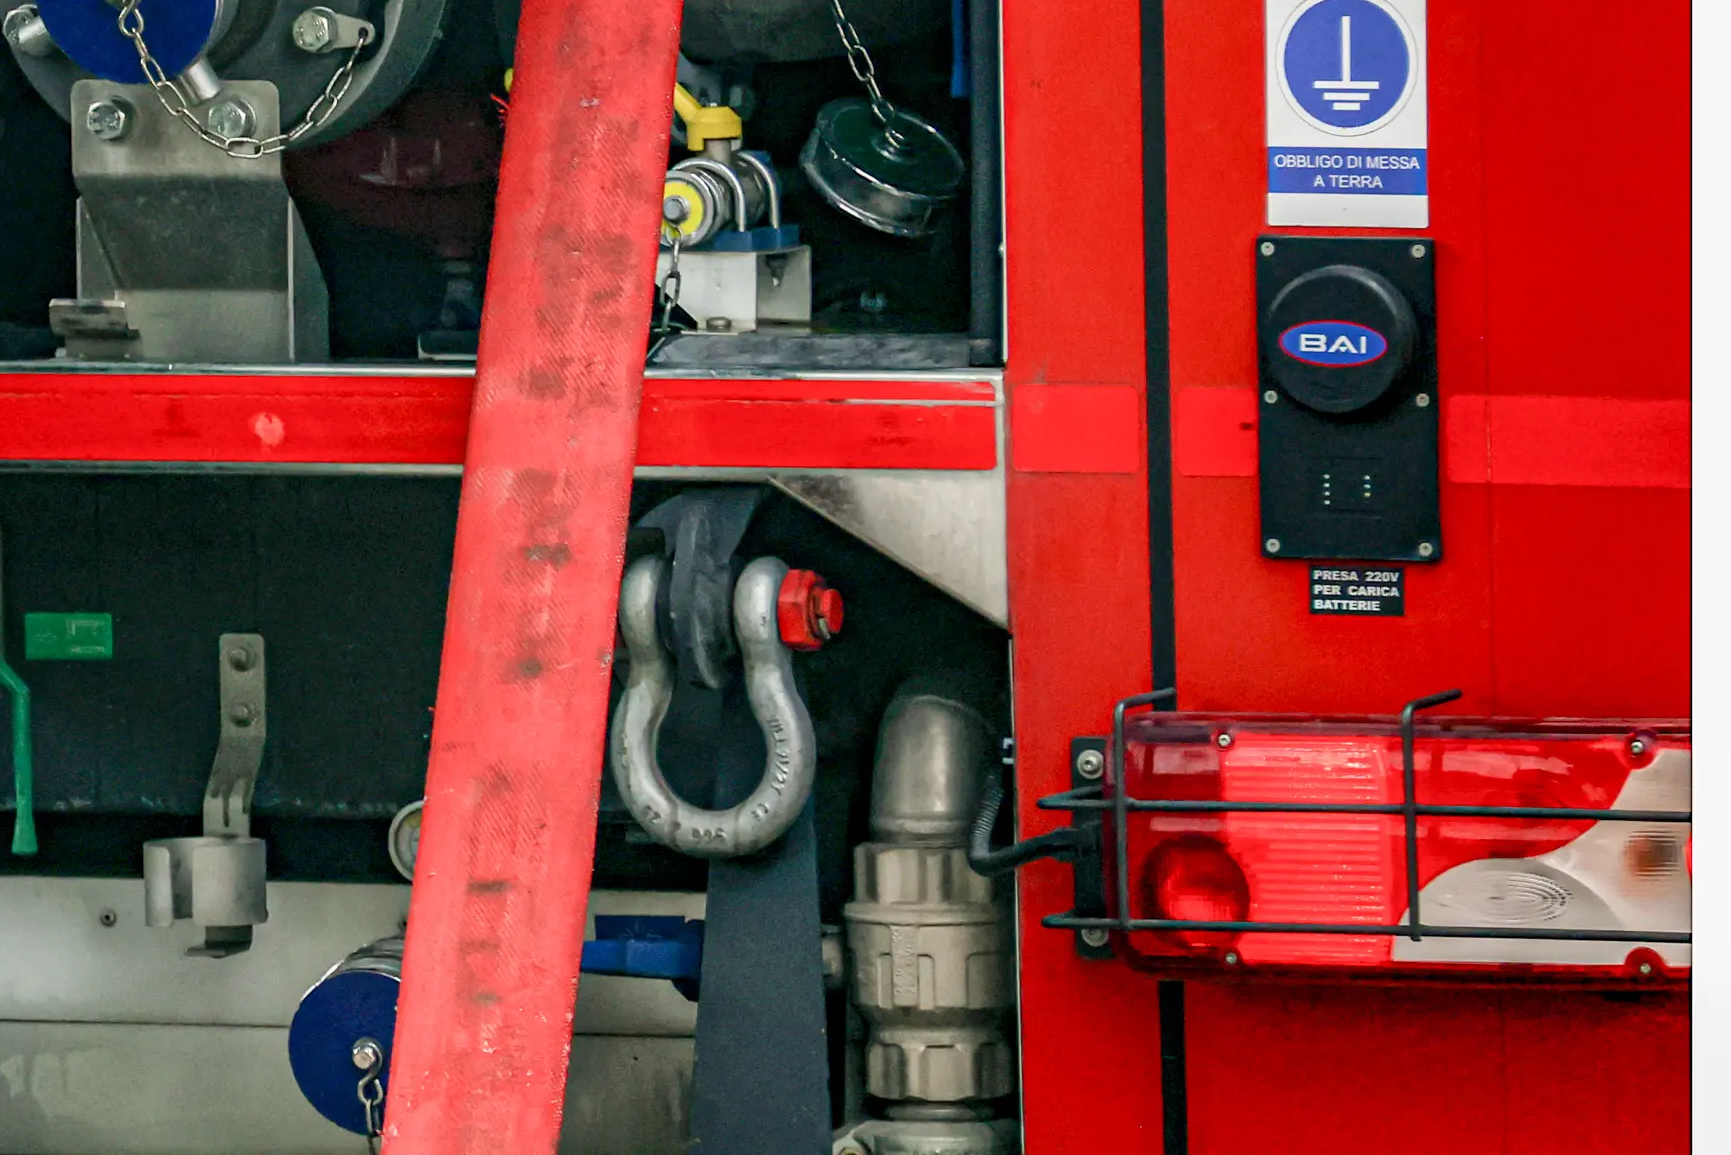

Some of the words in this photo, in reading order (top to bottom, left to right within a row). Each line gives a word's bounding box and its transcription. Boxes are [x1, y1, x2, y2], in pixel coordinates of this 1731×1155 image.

[1274, 154, 1344, 169] OBBLIGO
[1347, 155, 1363, 168] DI
[1366, 156, 1421, 170] MESSA
[1313, 174, 1326, 188] A
[1329, 175, 1384, 189] TERRA
[1299, 333, 1367, 355] BAI
[1313, 569, 1359, 581] PRESA
[1364, 570, 1400, 583] 220V
[1313, 584, 1342, 596] PER
[1347, 585, 1400, 598] CARICA
[1314, 599, 1381, 612] BATTERIE
